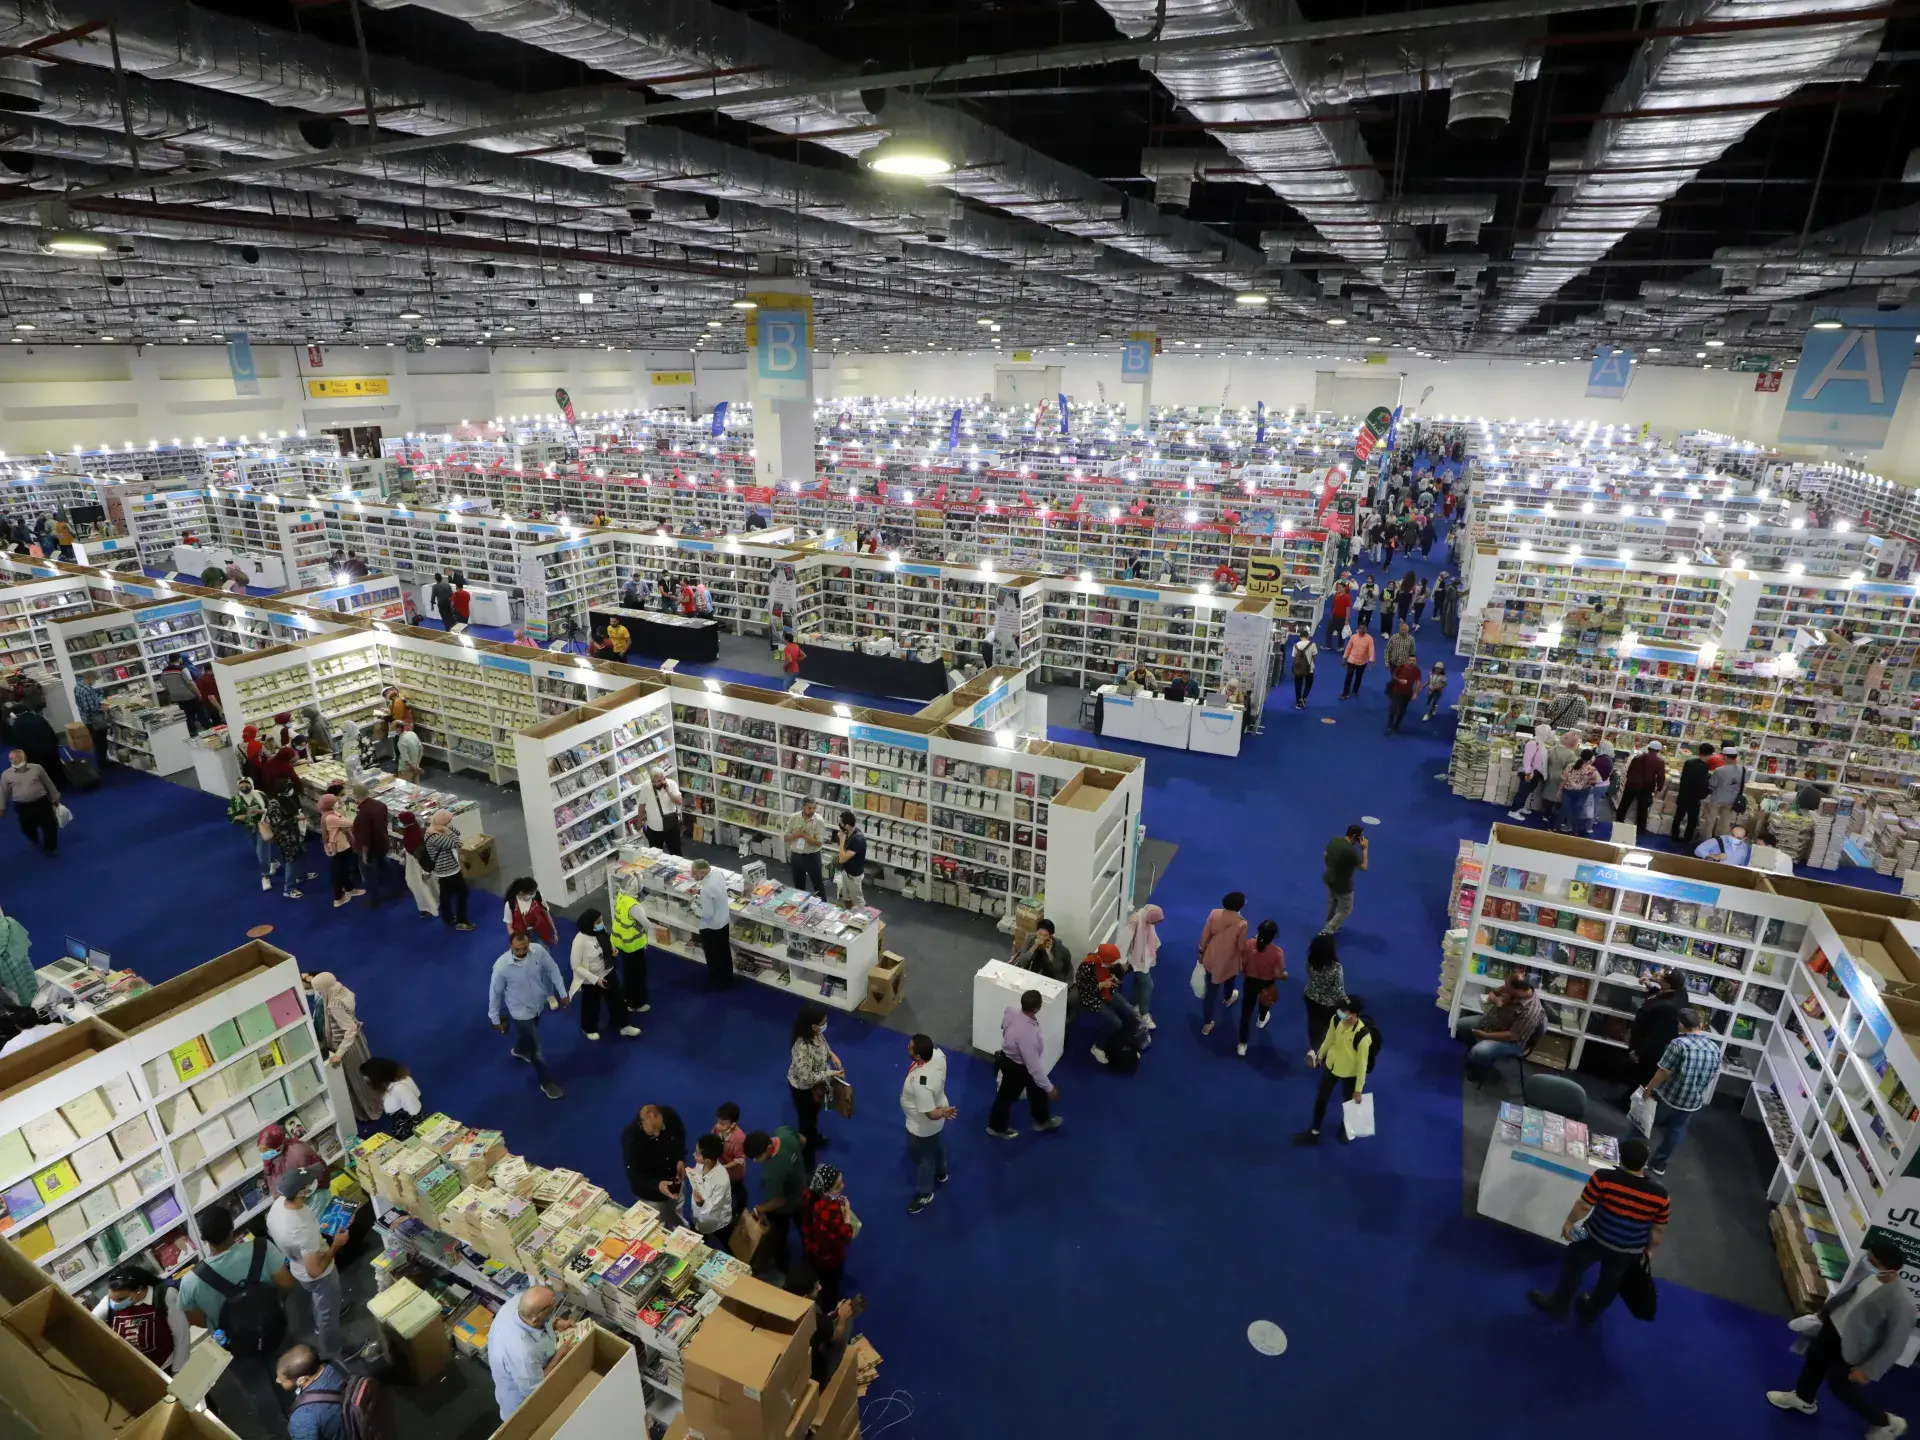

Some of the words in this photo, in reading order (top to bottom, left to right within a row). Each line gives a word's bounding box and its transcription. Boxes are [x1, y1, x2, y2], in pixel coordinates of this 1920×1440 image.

[767, 321, 798, 371] B
[1127, 344, 1146, 370] B
[1594, 353, 1624, 384] A
[1801, 324, 1885, 404] A
[1249, 581, 1280, 593] دارك
[1596, 869, 1620, 881] A61
